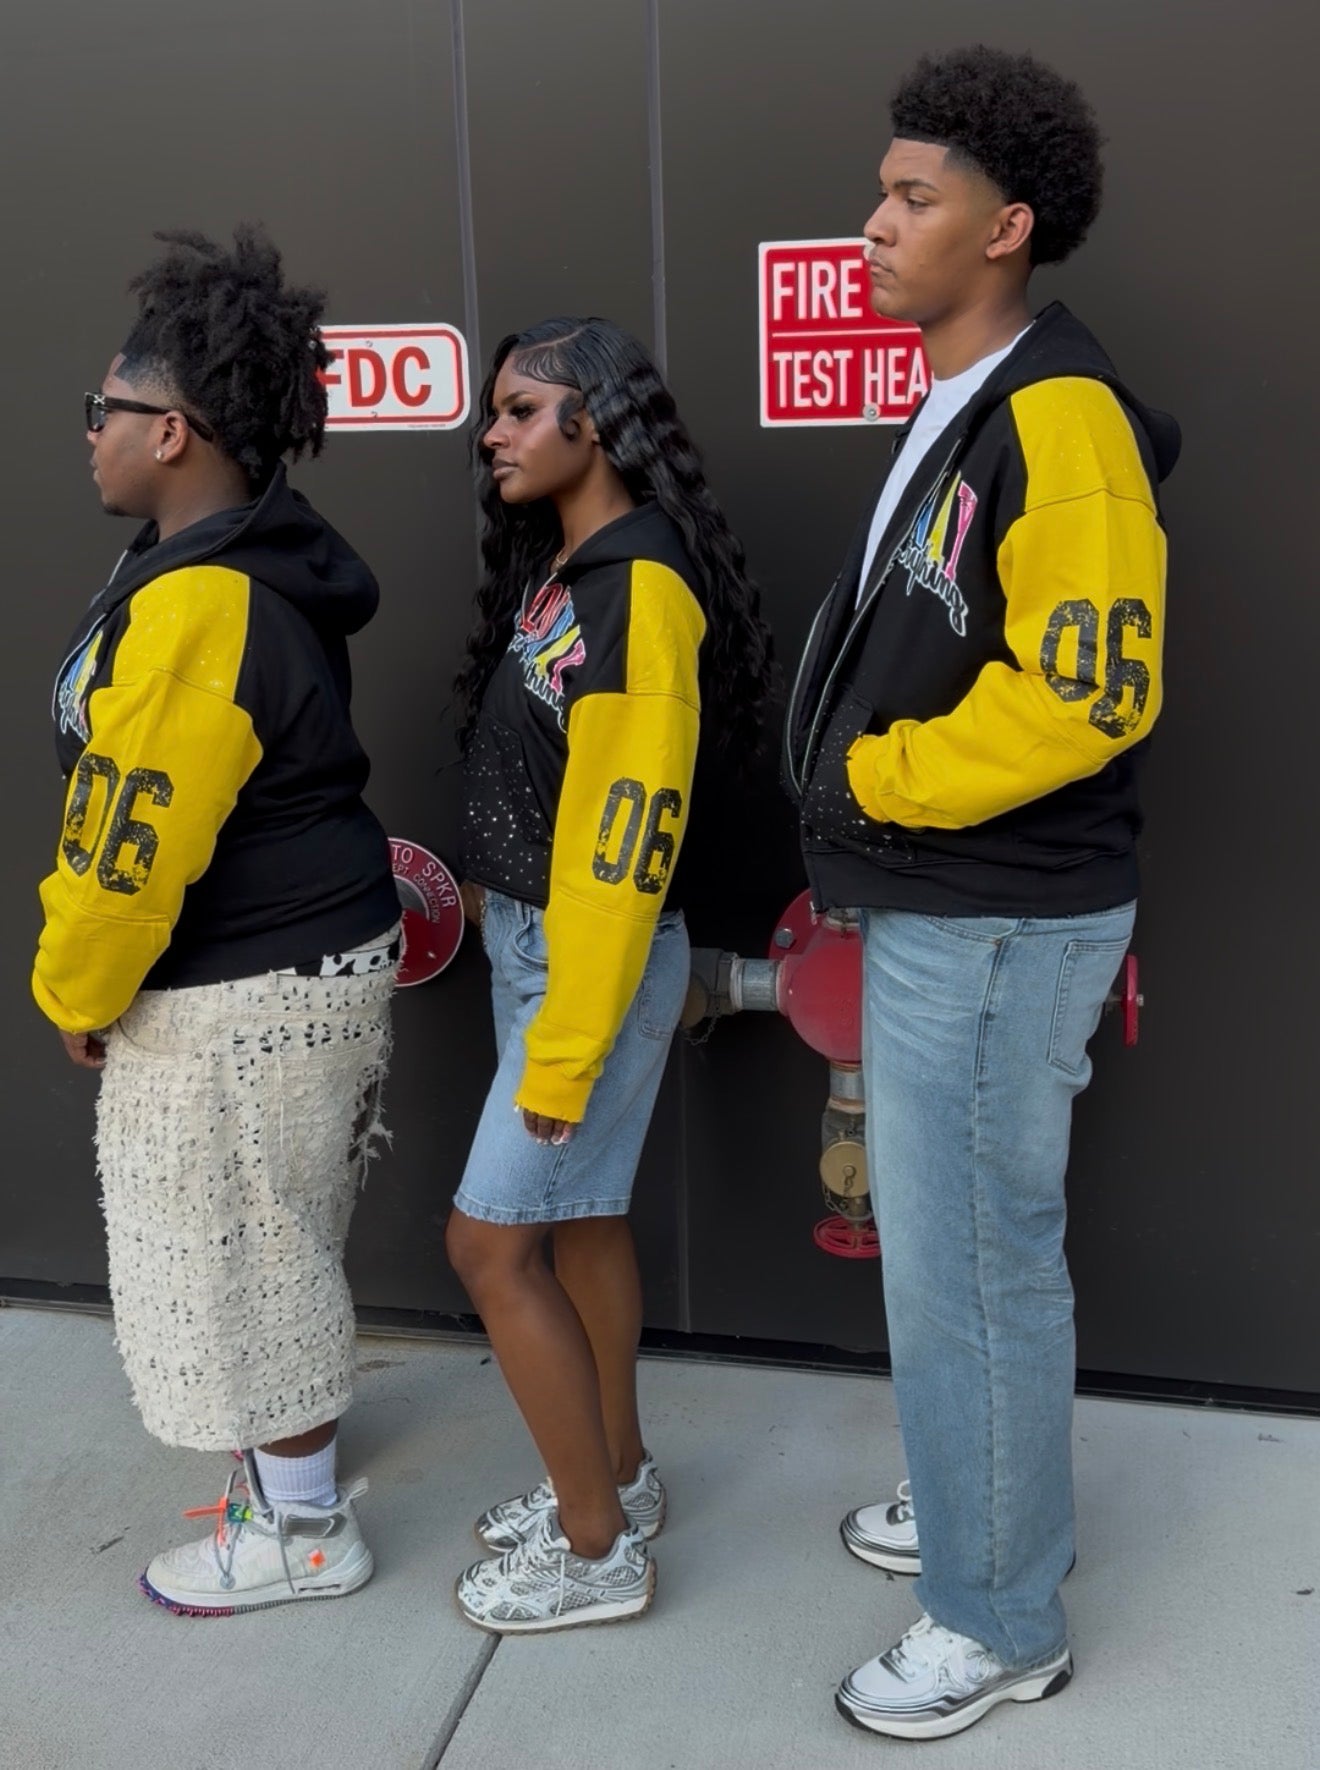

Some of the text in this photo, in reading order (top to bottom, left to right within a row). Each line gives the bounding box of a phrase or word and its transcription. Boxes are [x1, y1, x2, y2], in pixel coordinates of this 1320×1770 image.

[773, 259, 863, 320] FIRE
[773, 347, 934, 408] TEST HEA
[1039, 597, 1153, 739] 06
[61, 752, 174, 896] 06
[592, 777, 682, 895] 06
[422, 861, 457, 908] SPKR
